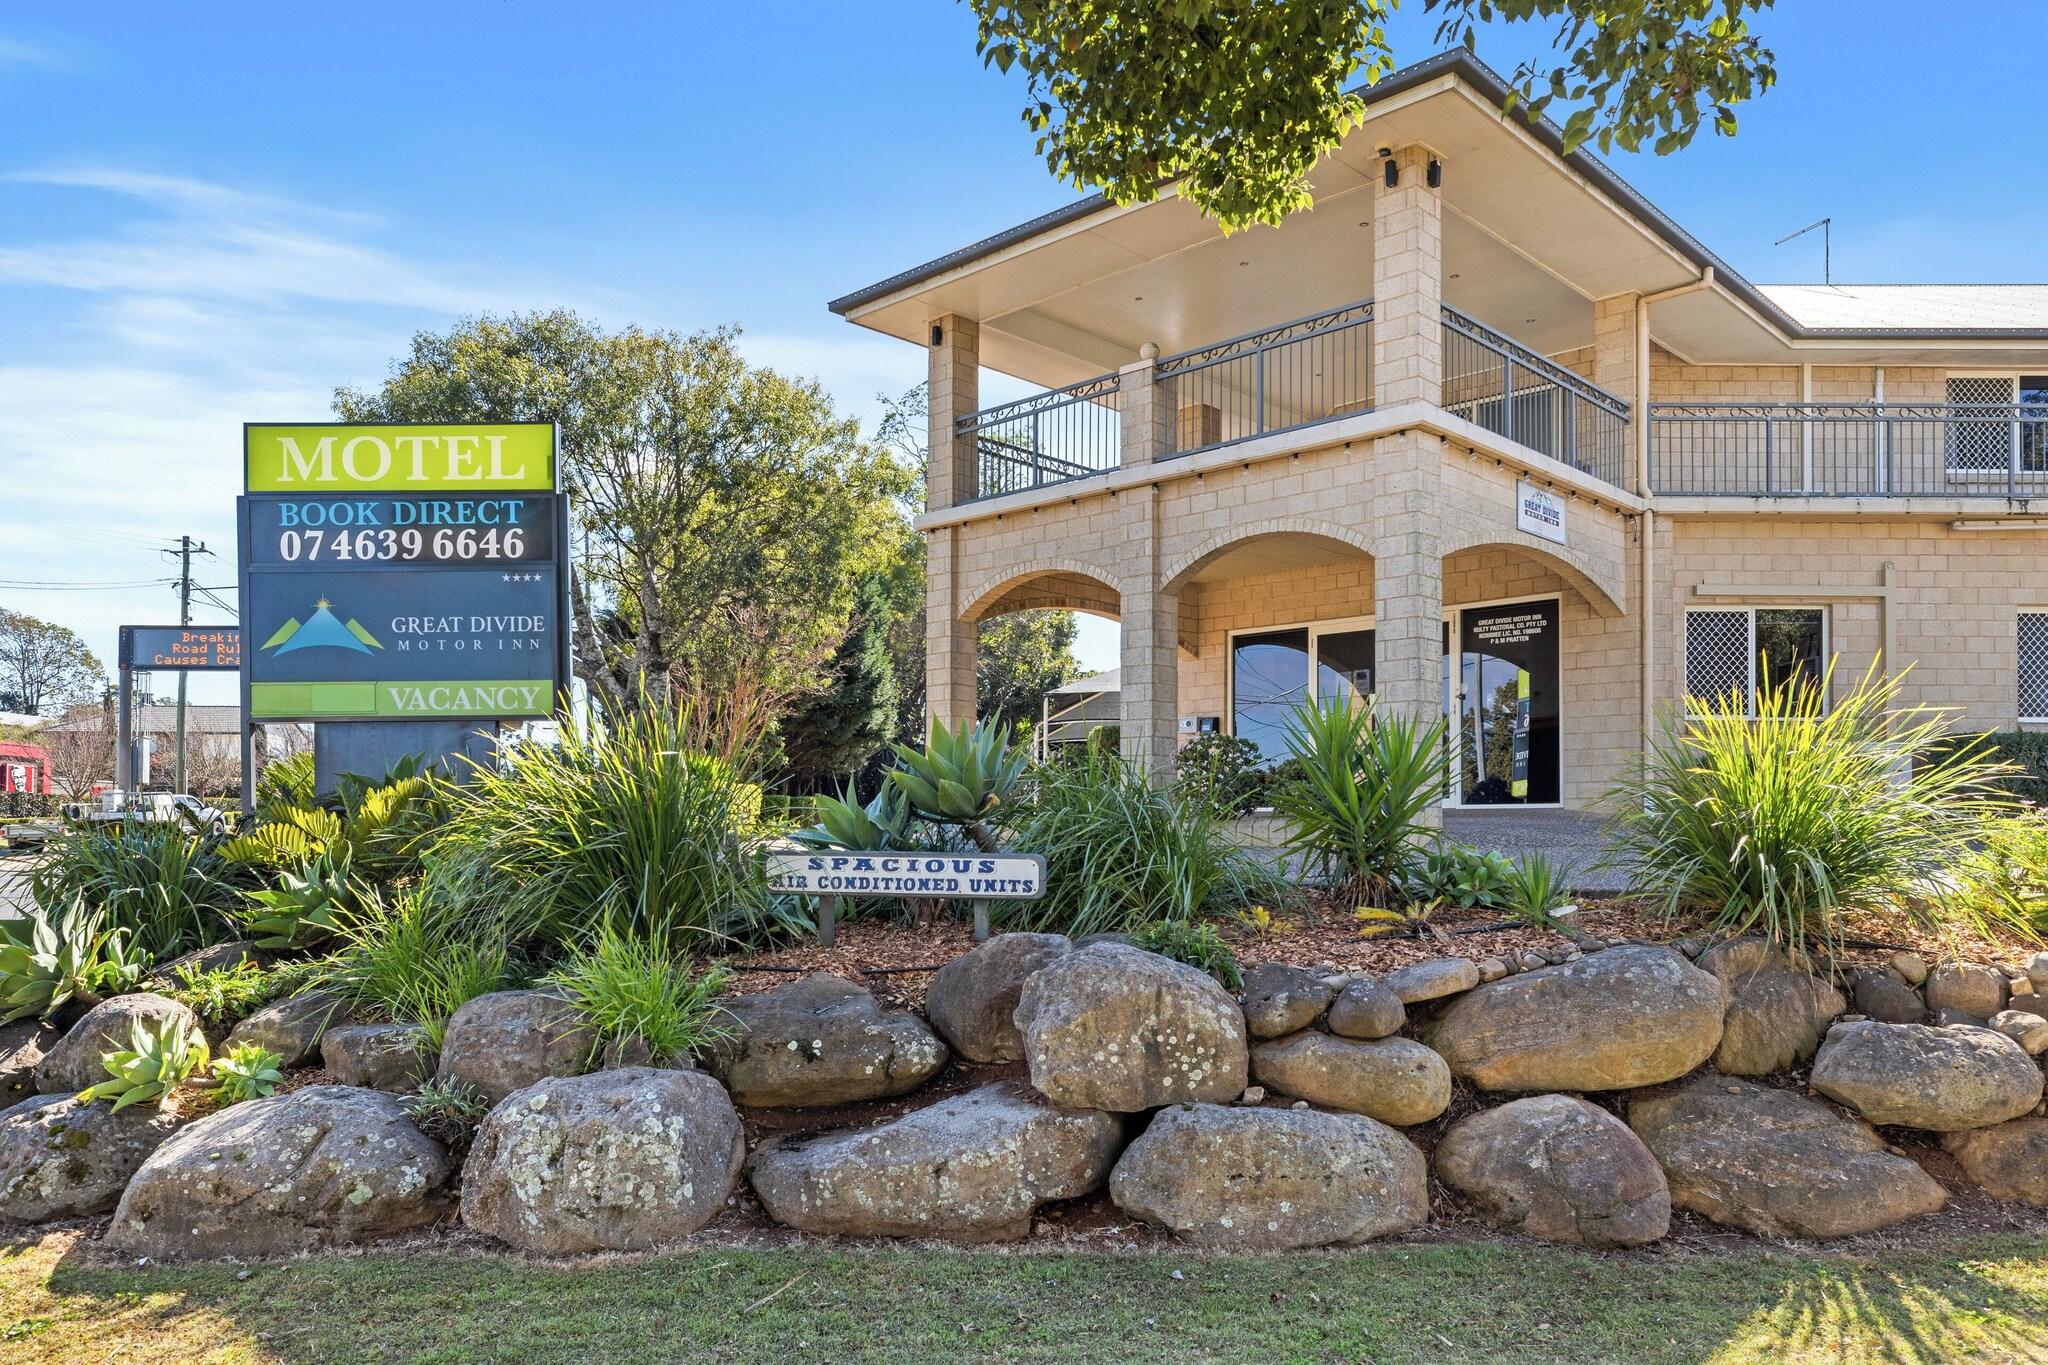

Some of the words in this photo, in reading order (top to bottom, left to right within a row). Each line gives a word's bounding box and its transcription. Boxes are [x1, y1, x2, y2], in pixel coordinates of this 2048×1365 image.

[276, 435, 526, 482] MOTEL
[278, 502, 382, 526] BOOK
[392, 500, 525, 525] DIRECT
[1524, 499, 1541, 513] GREAT
[1542, 506, 1559, 520] DIVIDE
[280, 530, 325, 561] 07
[331, 528, 423, 560] 4639
[433, 527, 525, 559] 6646
[391, 617, 463, 636] GREAT
[470, 615, 545, 633] DIVIDE
[1490, 623, 1516, 631] PASTORAL
[1537, 619, 1547, 627] LTD
[397, 639, 482, 651] MOTOR
[498, 638, 542, 650] INN
[1479, 631, 1501, 639] NOMINEE
[172, 643, 208, 654] Road
[154, 654, 208, 665] Causes
[388, 686, 541, 711] VACANCY
[808, 857, 998, 874] SPACIOUS
[772, 874, 808, 889] AIR
[818, 876, 959, 893] CONDITIONED
[970, 878, 1034, 893] UNITS
